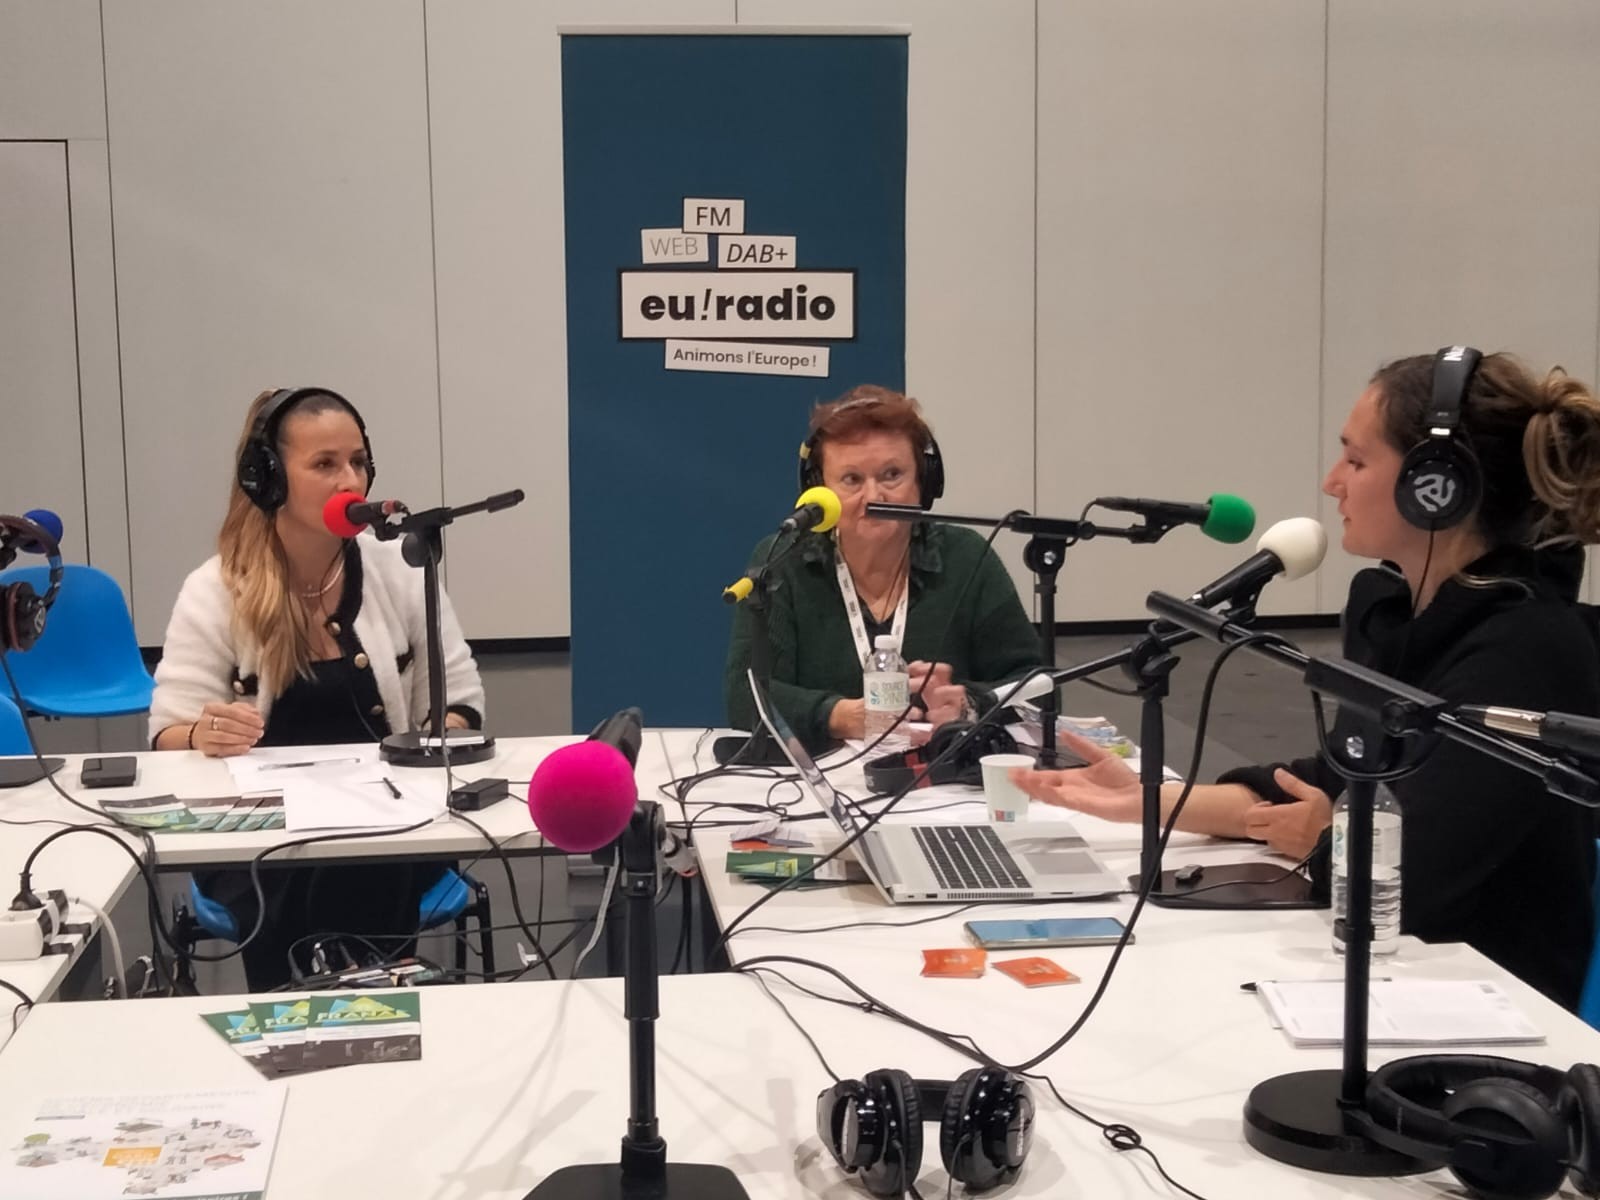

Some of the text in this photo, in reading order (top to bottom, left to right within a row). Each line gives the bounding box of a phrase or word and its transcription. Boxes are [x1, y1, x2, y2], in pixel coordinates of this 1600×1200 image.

[696, 206, 731, 227] FM
[650, 237, 698, 256] WEB
[726, 243, 788, 263] DAB+
[640, 284, 836, 321] eu!radio
[673, 348, 744, 364] Animons
